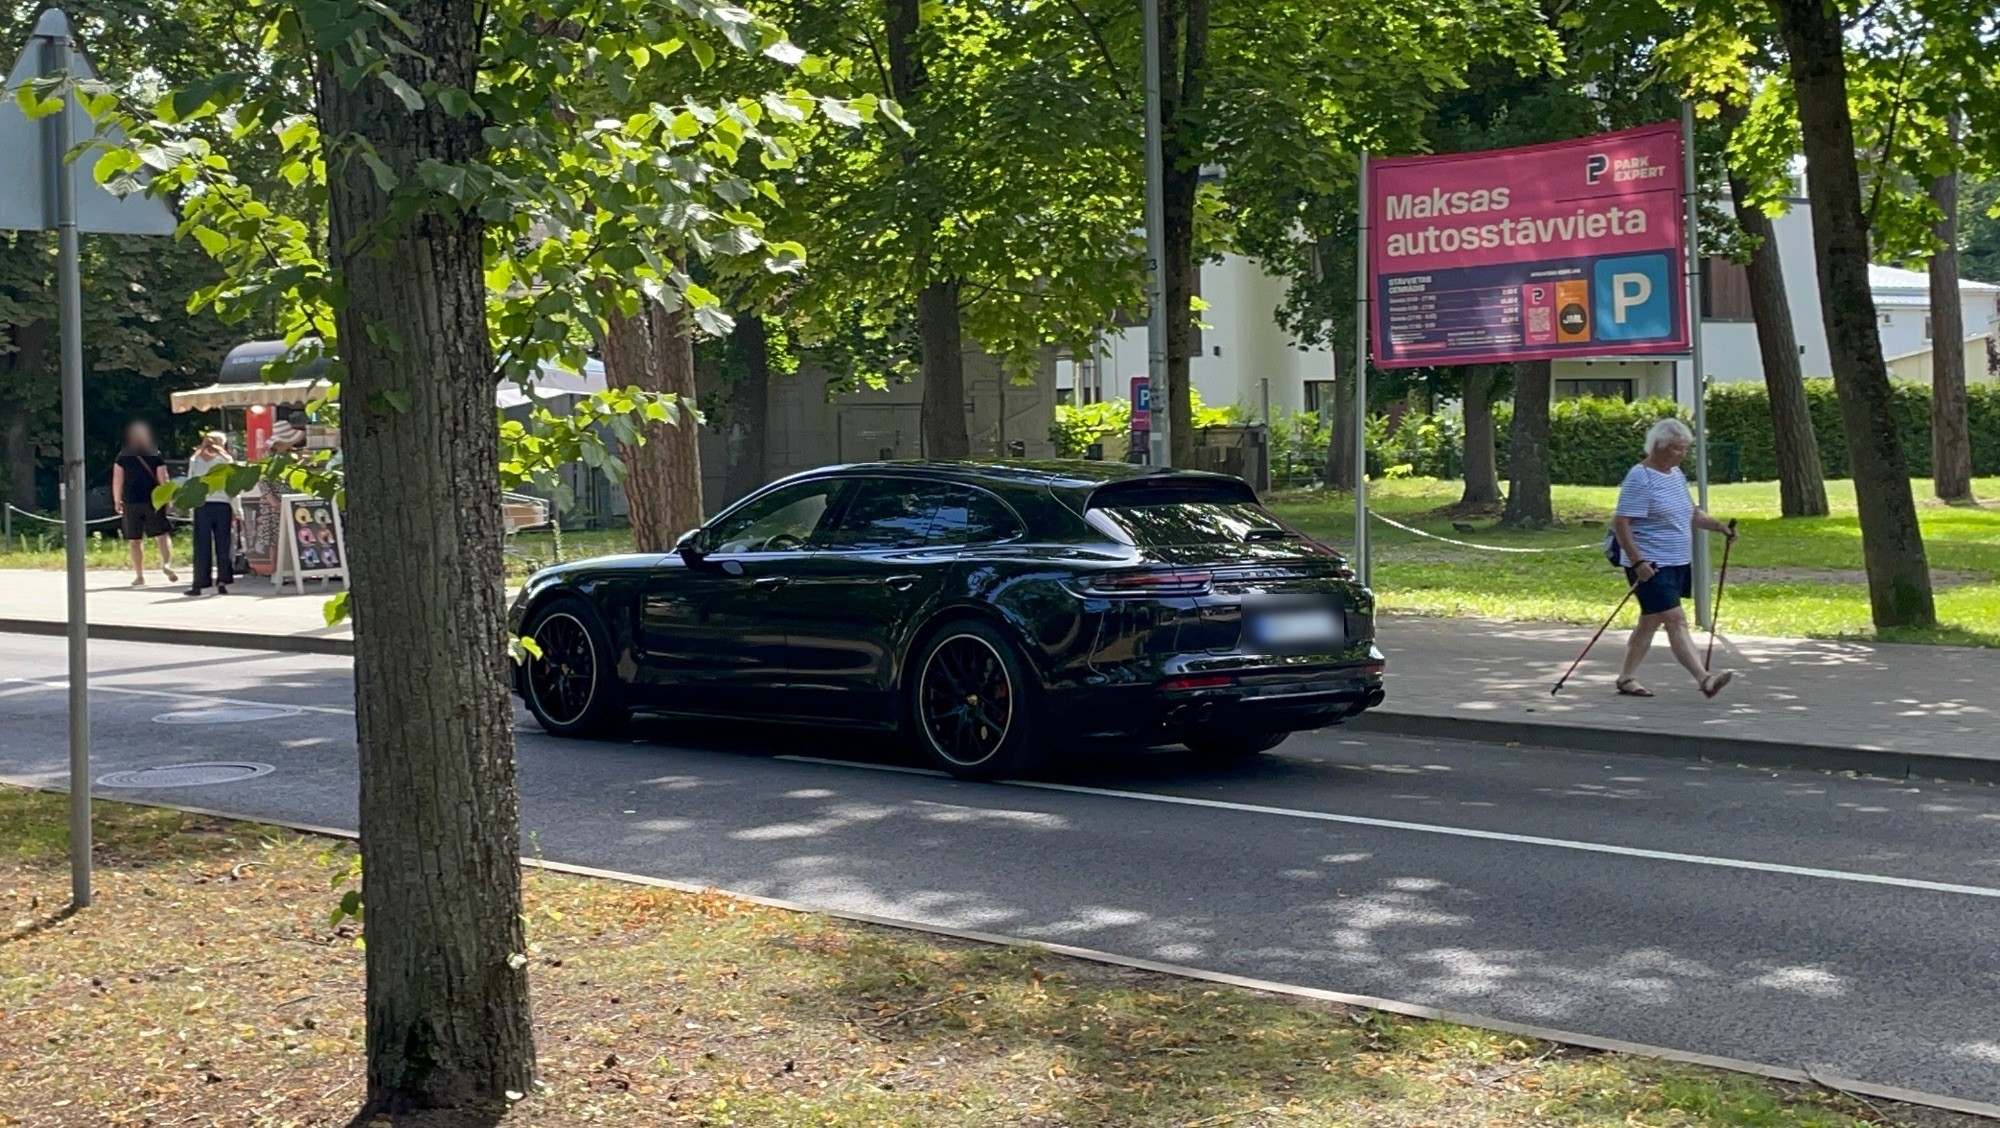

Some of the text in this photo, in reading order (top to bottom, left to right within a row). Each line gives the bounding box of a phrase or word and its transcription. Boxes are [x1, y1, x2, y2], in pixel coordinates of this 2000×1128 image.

[1613, 155, 1650, 171] PARK
[1613, 165, 1666, 182] EXPERT
[1386, 187, 1511, 221] Maksas
[1386, 206, 1647, 257] autosstāvvieta
[1612, 272, 1653, 324] P
[1140, 389, 1150, 407] P
